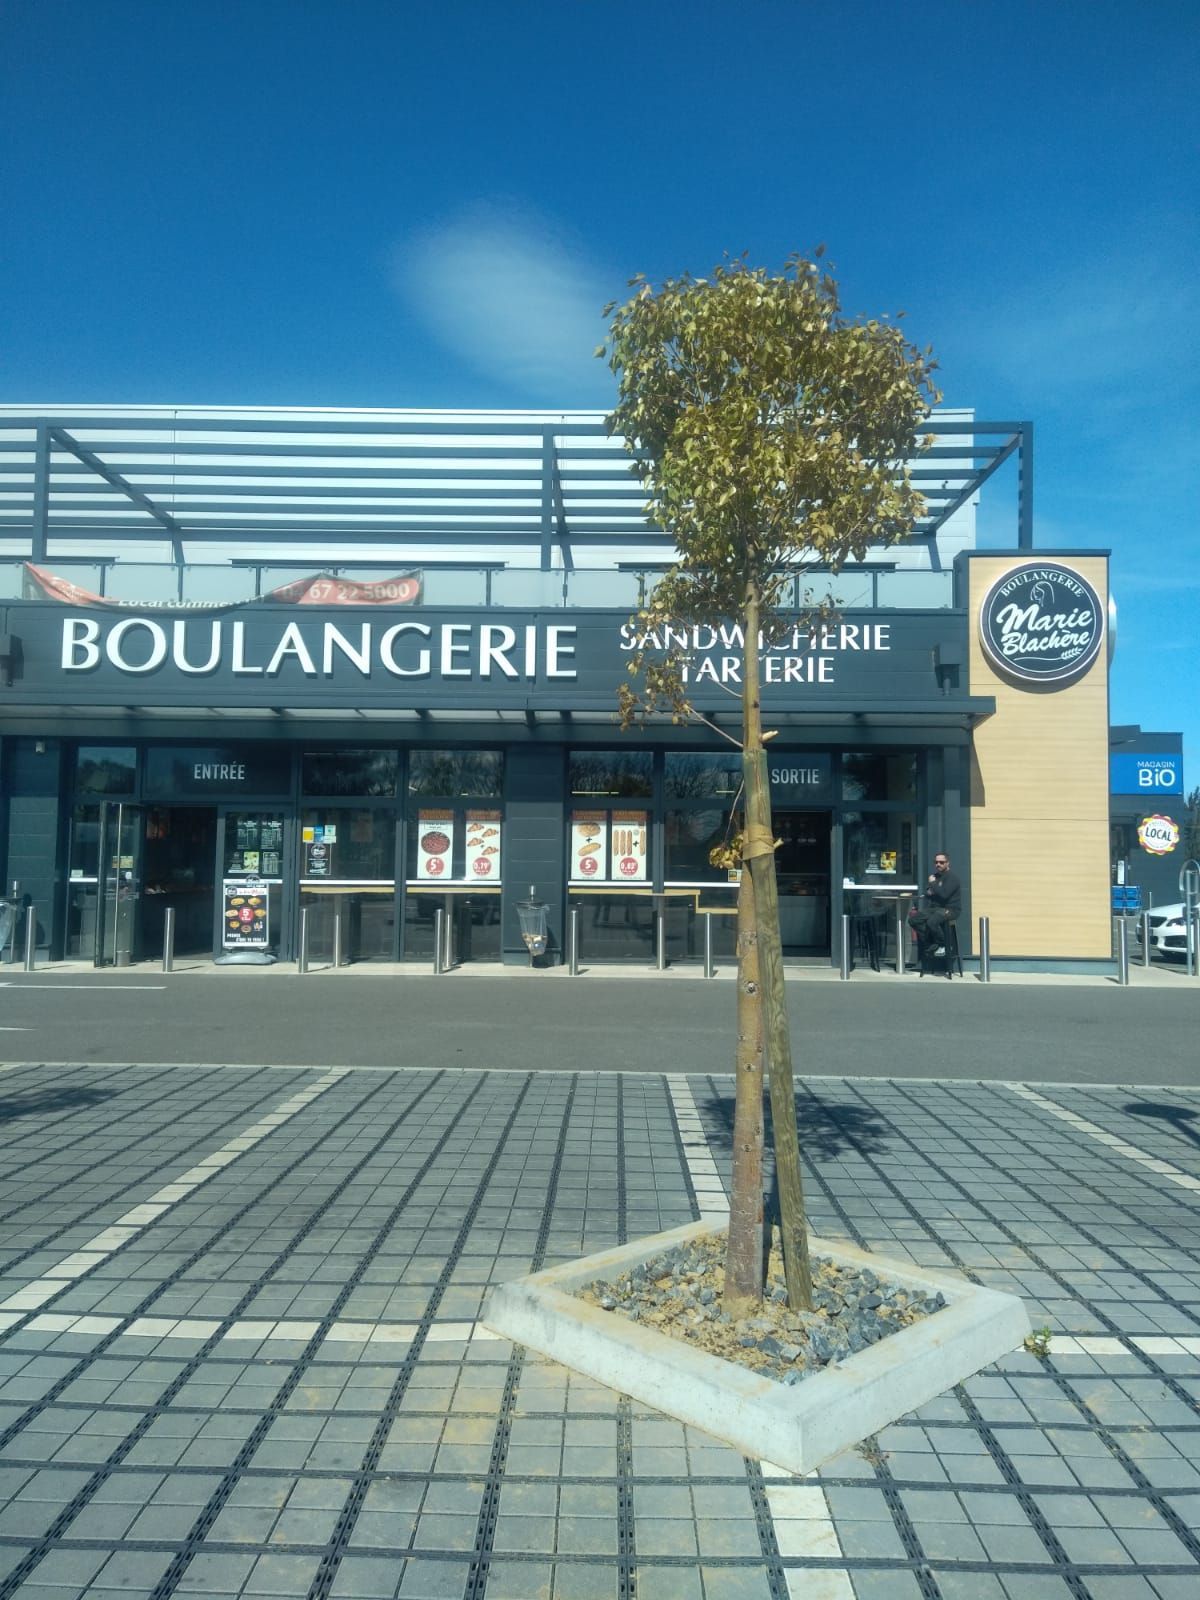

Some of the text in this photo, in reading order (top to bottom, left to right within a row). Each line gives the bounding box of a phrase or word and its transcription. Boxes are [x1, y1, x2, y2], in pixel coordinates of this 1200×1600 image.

[309, 584, 332, 599] 67
[336, 584, 359, 600] 22
[1000, 571, 1084, 598] BOULANGERIE
[996, 603, 1093, 635] Marie
[61, 618, 577, 677] BOULANGERIE
[1001, 629, 1091, 656] Blachère
[678, 656, 835, 683] TARERIE
[194, 760, 246, 780] ENTRÉE
[771, 768, 820, 784] SORTIE
[1145, 826, 1172, 842] LOCAL
